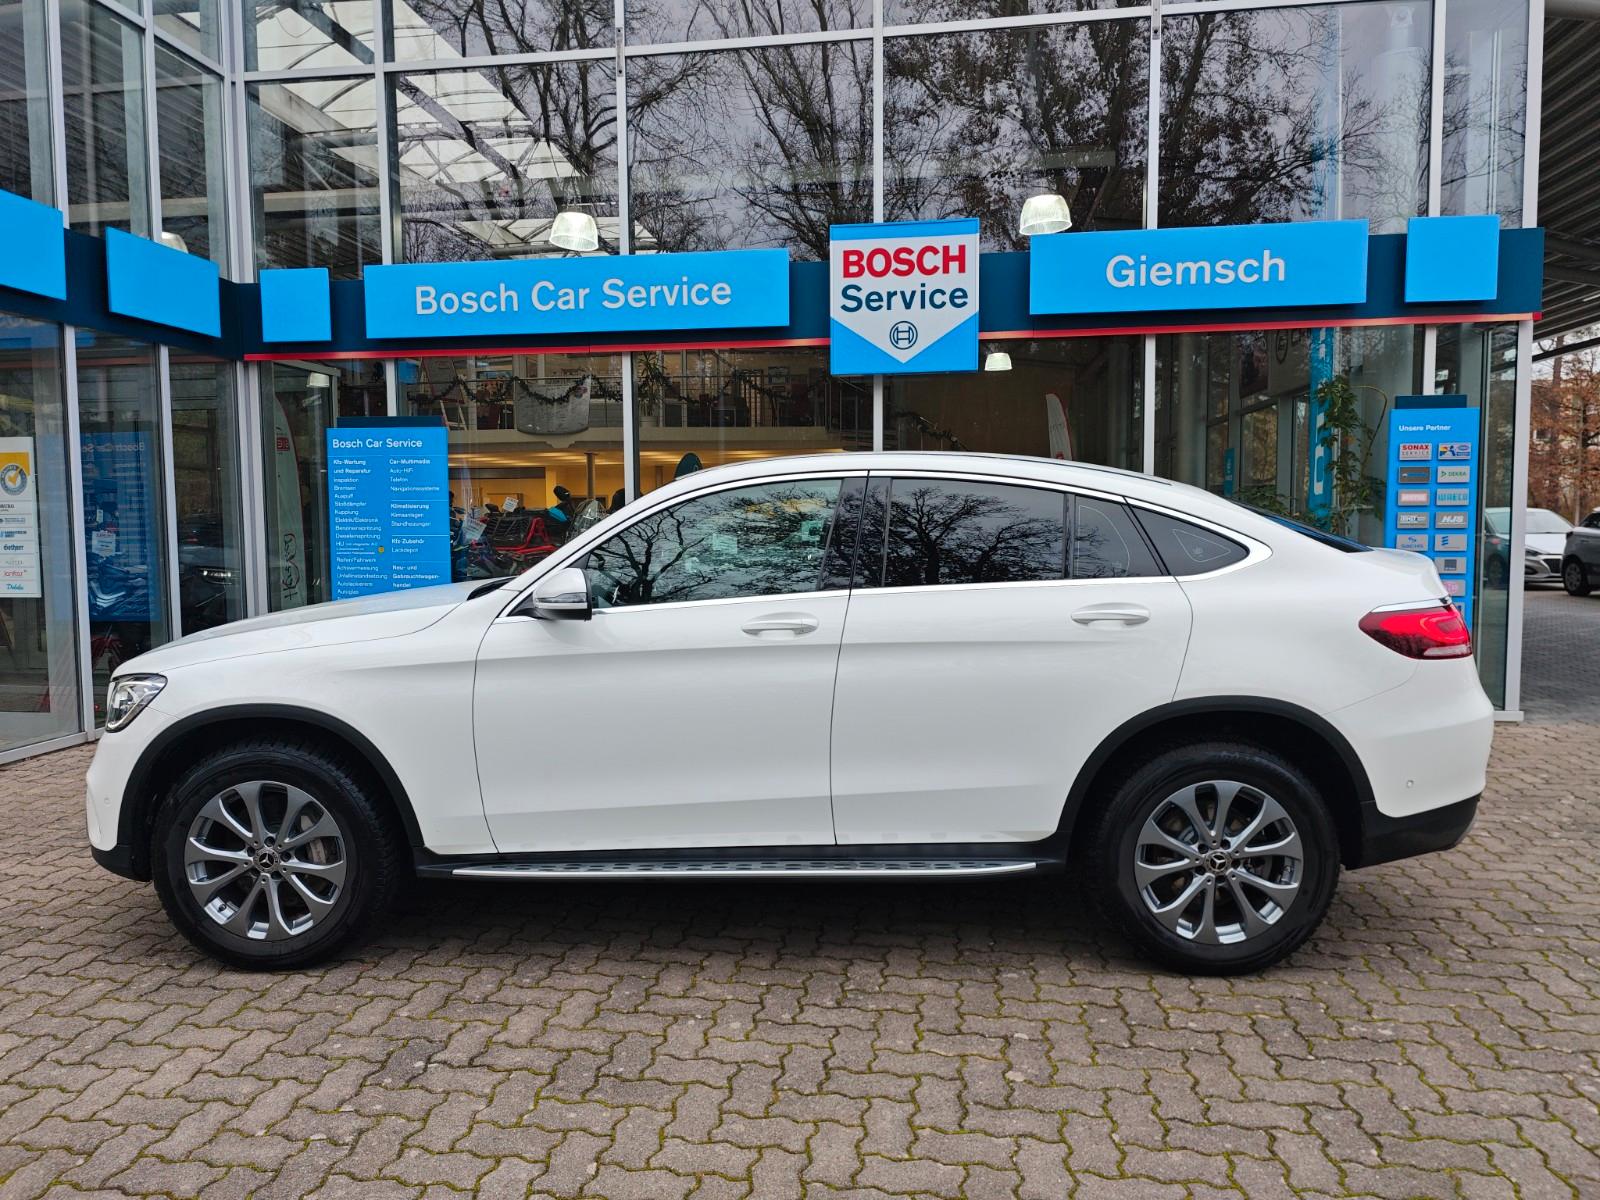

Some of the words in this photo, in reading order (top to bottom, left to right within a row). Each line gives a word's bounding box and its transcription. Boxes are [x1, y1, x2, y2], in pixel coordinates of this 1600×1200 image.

[842, 244, 966, 279] BOSCH
[1105, 249, 1286, 288] Giemsch
[415, 283, 519, 315] Bosch
[531, 280, 590, 311] Car
[601, 276, 732, 309] Service
[840, 282, 969, 313] Service
[332, 439, 362, 448] Bosch
[366, 439, 382, 448] Car
[386, 438, 422, 448] Service
